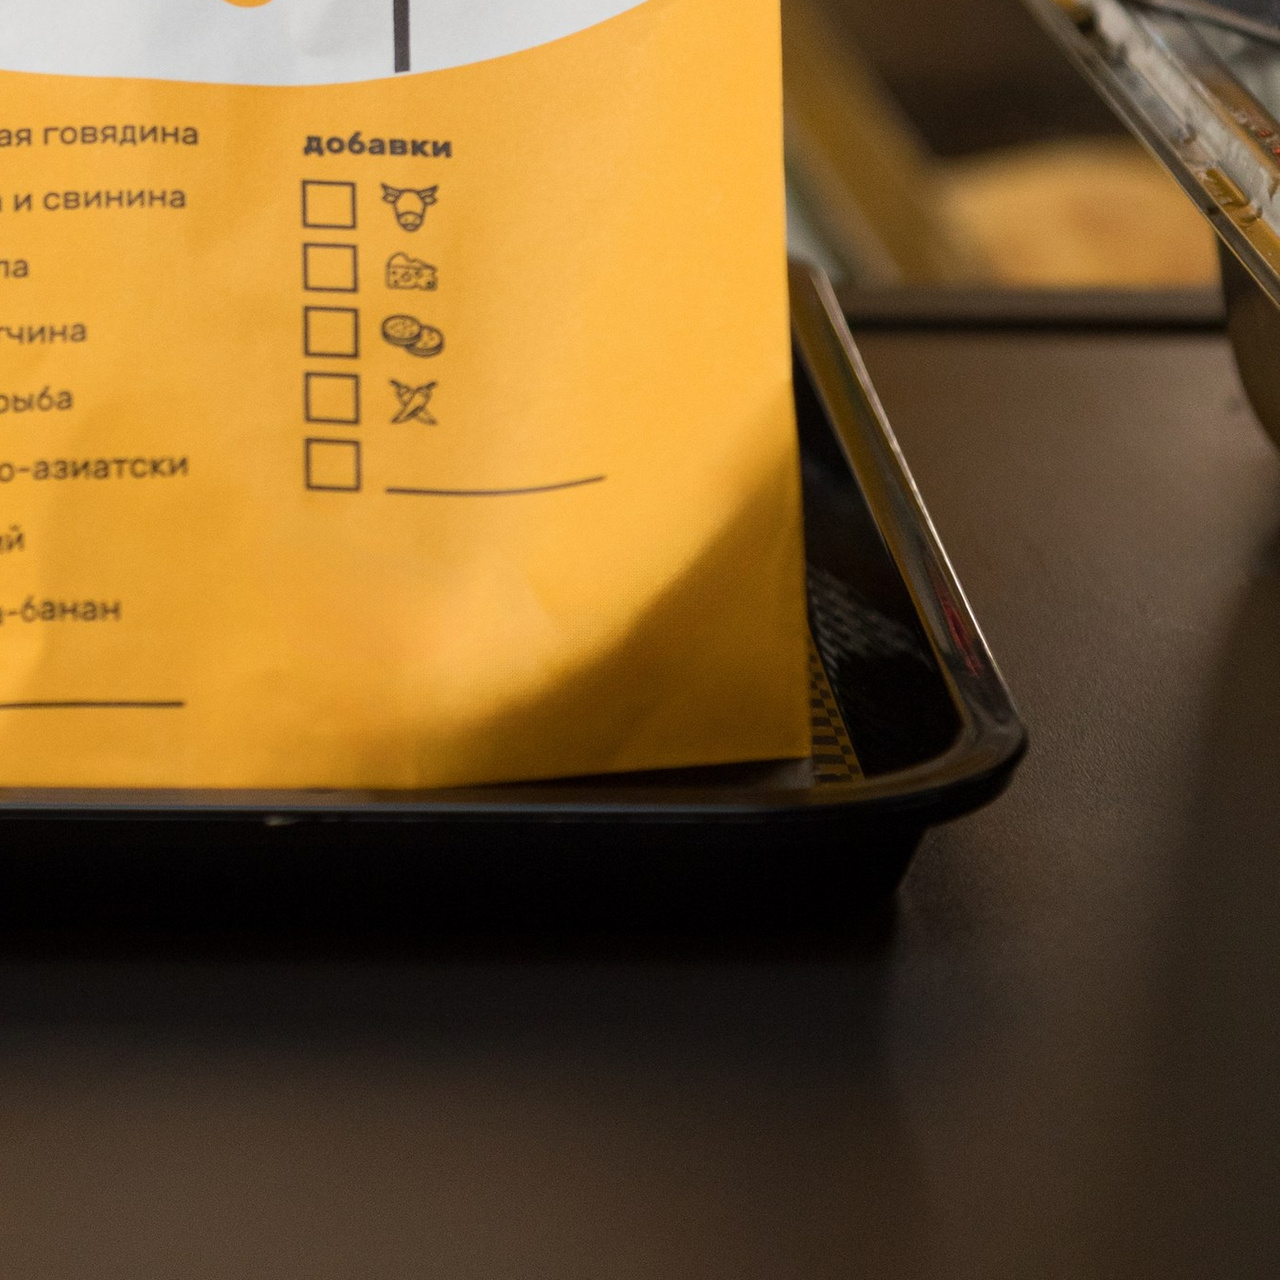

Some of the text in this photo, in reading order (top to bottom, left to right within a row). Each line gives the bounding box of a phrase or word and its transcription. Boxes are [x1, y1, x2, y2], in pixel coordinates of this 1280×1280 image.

[43, 124, 199, 147] говядина
[304, 131, 453, 158] добавки
[13, 193, 32, 212] и
[43, 189, 187, 211] свинина
